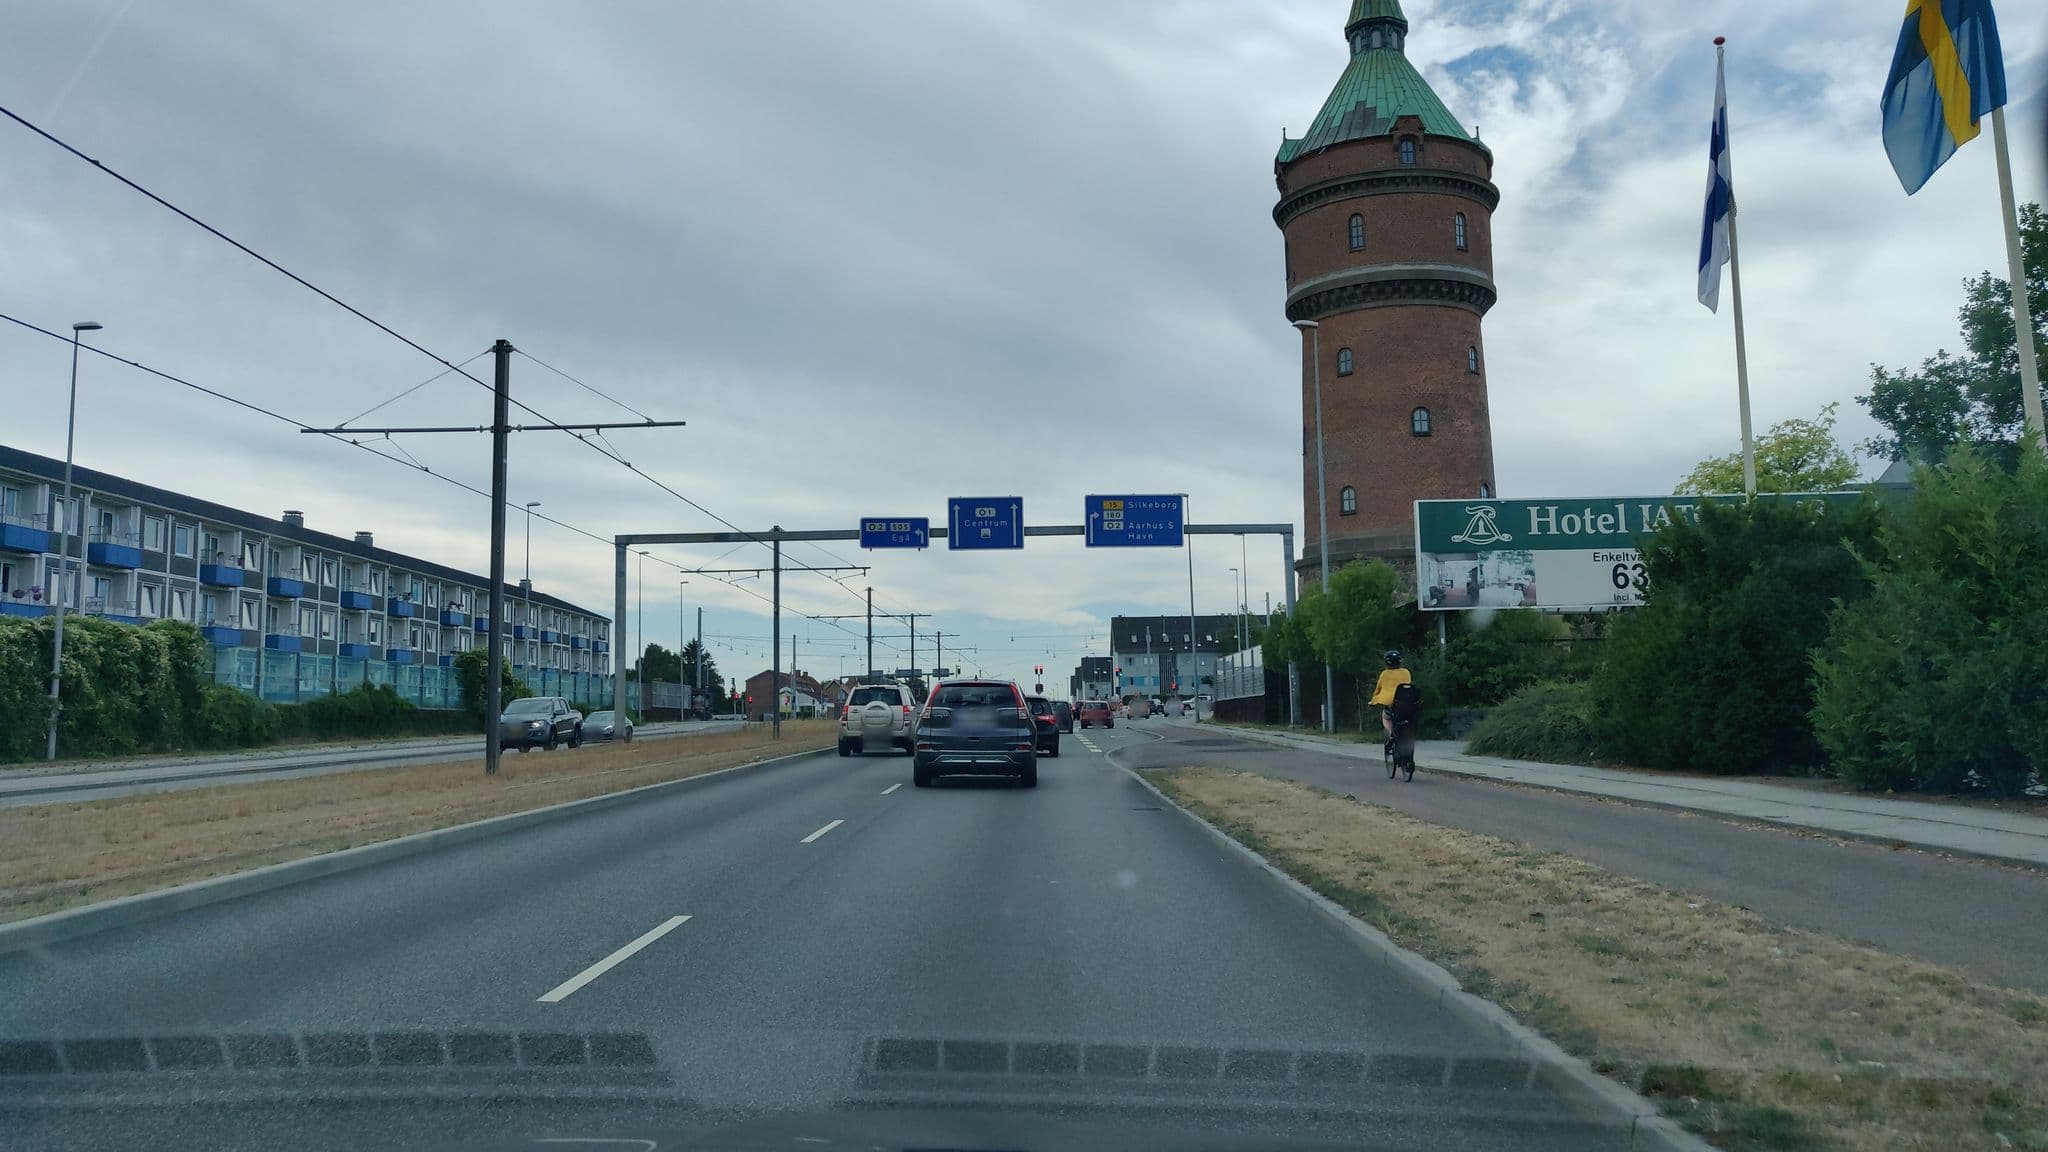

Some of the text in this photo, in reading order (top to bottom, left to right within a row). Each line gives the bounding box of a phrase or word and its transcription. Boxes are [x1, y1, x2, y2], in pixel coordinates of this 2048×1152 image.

[1128, 501, 1177, 510] Silkeborg
[963, 519, 1008, 527] Centrum
[1527, 503, 1629, 535] Hotel
[892, 523, 909, 531] 505
[1128, 522, 1164, 530] Aarhus
[1168, 521, 1175, 530] S
[892, 533, 910, 543] Egå
[1128, 532, 1154, 540] Havn
[1612, 563, 1649, 590] 63
